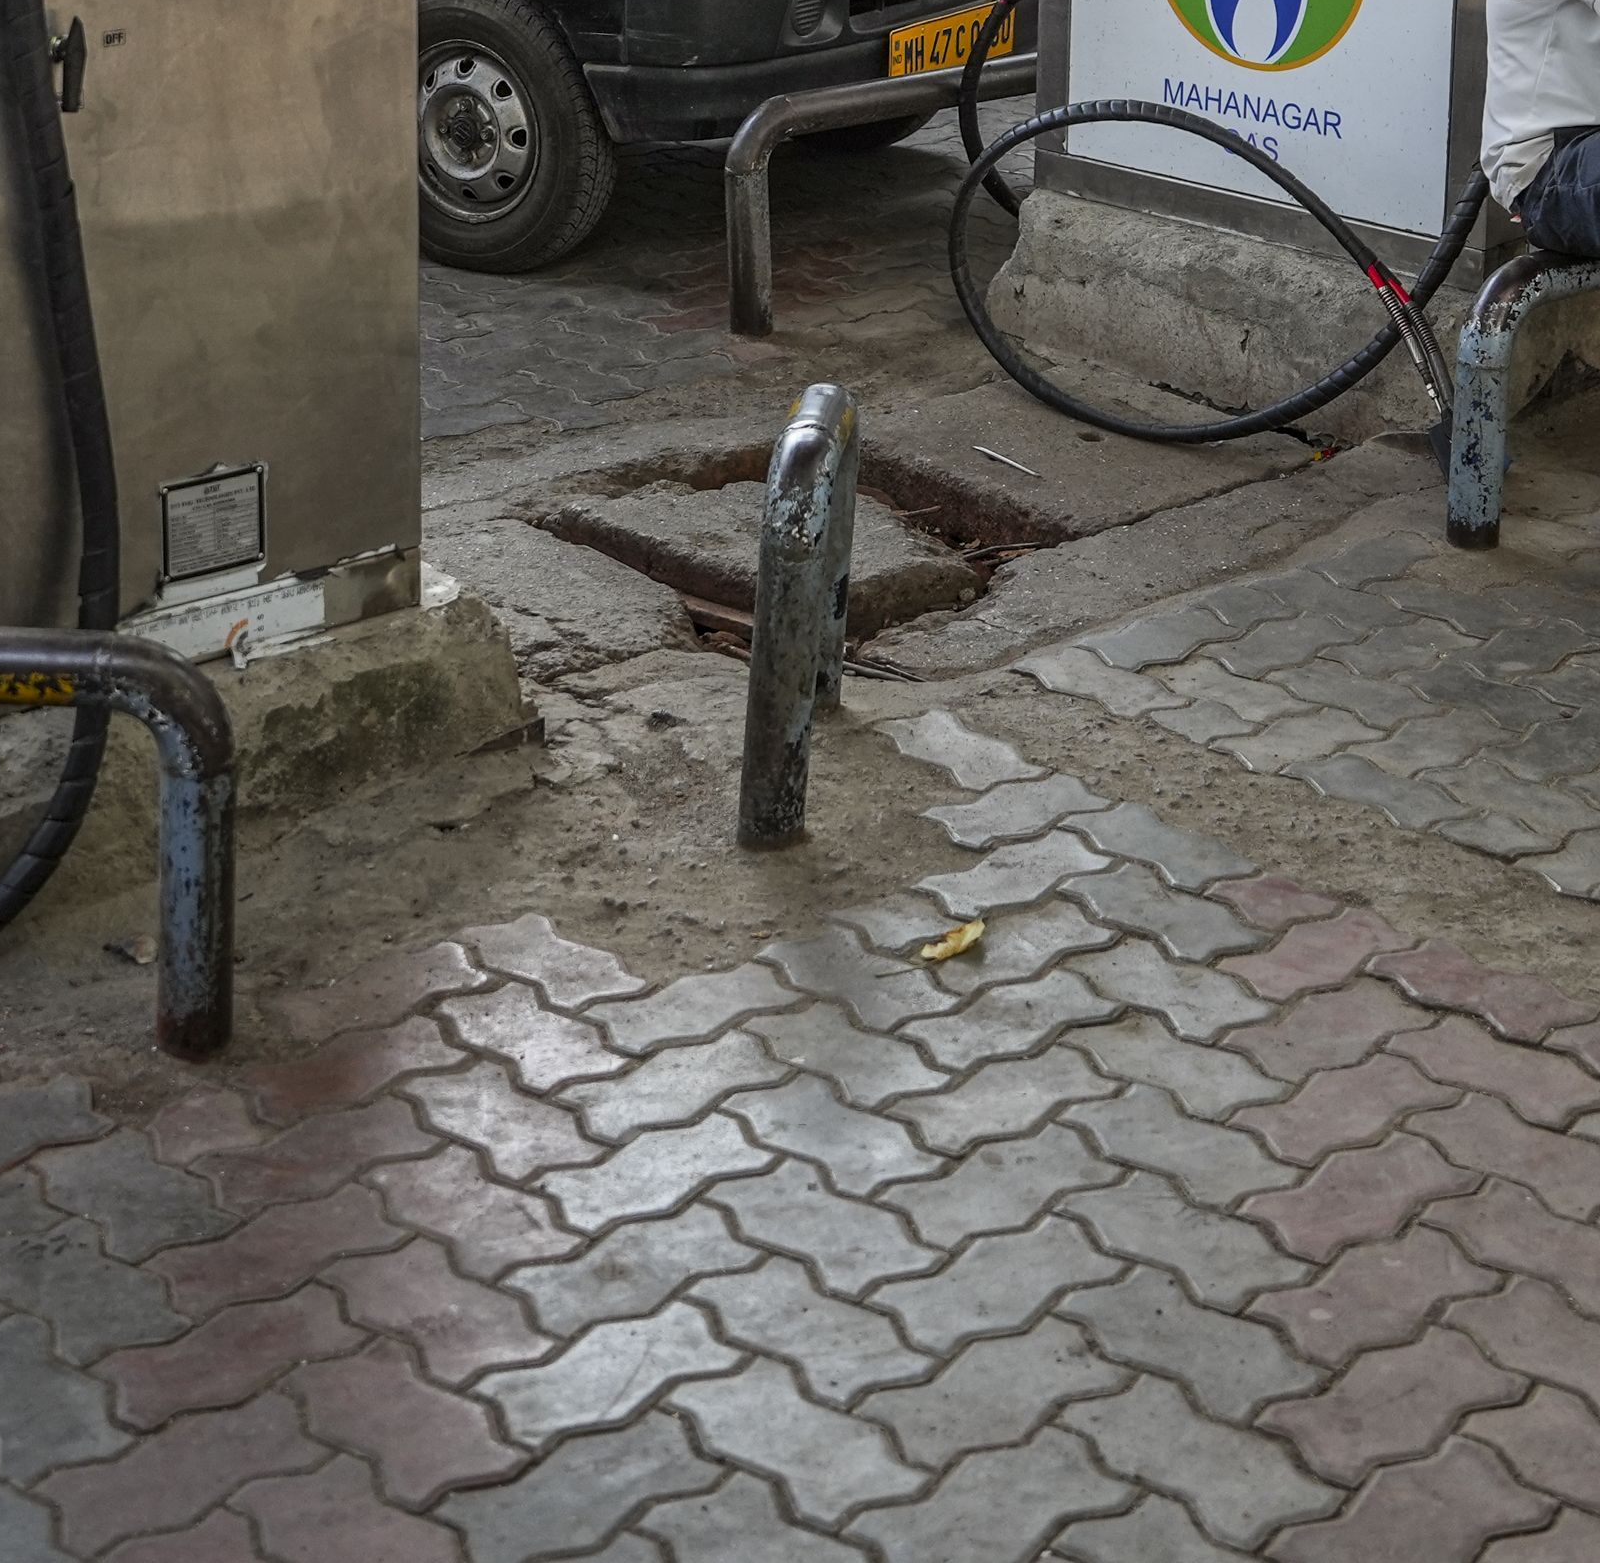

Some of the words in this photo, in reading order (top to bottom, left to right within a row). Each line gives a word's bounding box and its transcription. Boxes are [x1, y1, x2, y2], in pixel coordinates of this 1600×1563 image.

[105, 32, 124, 45] OFF
[904, 35, 925, 75] MH
[929, 26, 953, 66] 47
[955, 24, 966, 59] C
[1162, 77, 1343, 140] MAHANAGAR
